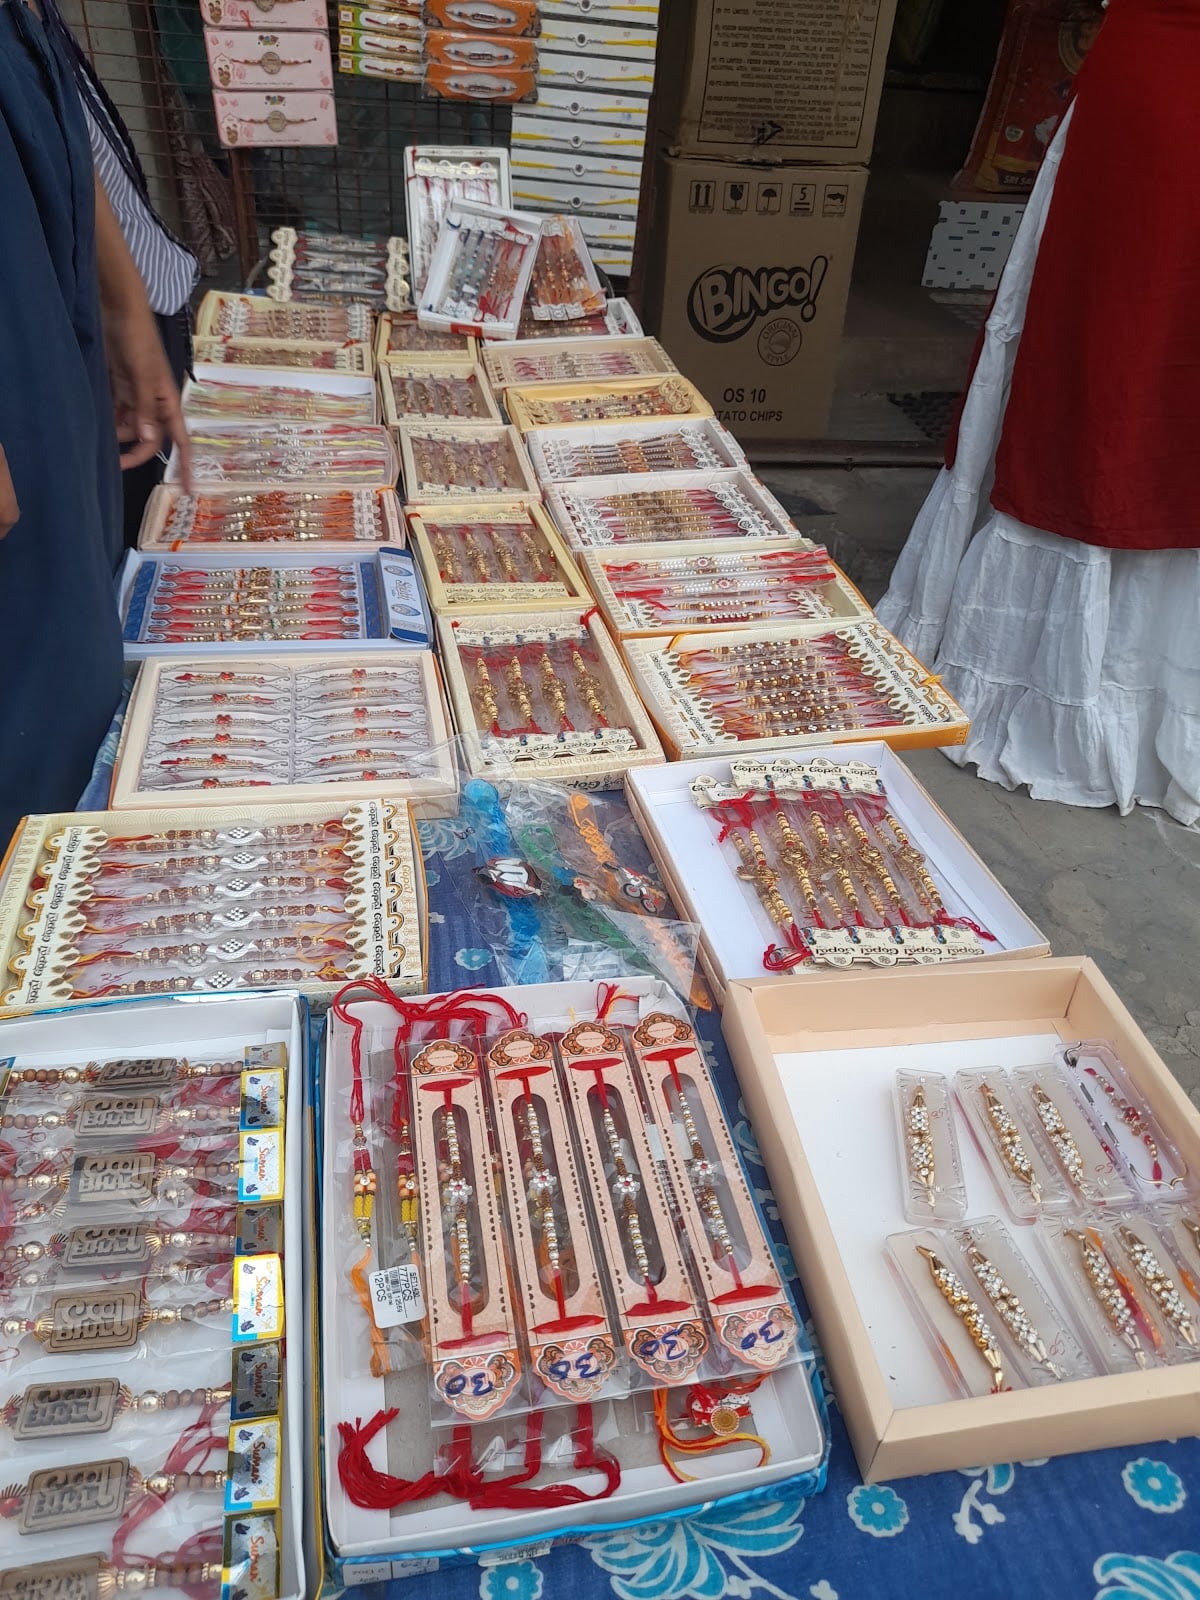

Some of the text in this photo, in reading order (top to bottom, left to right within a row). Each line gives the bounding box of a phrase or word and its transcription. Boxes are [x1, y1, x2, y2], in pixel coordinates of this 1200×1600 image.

[697, 255, 829, 332] BINGO!
[723, 387, 766, 404] OS 10
[717, 410, 783, 422] TATO CHIPS
[26, 979, 42, 1004] opal
[374, 1272, 387, 1302] 12PCS
[399, 1266, 413, 1302] 777PCS
